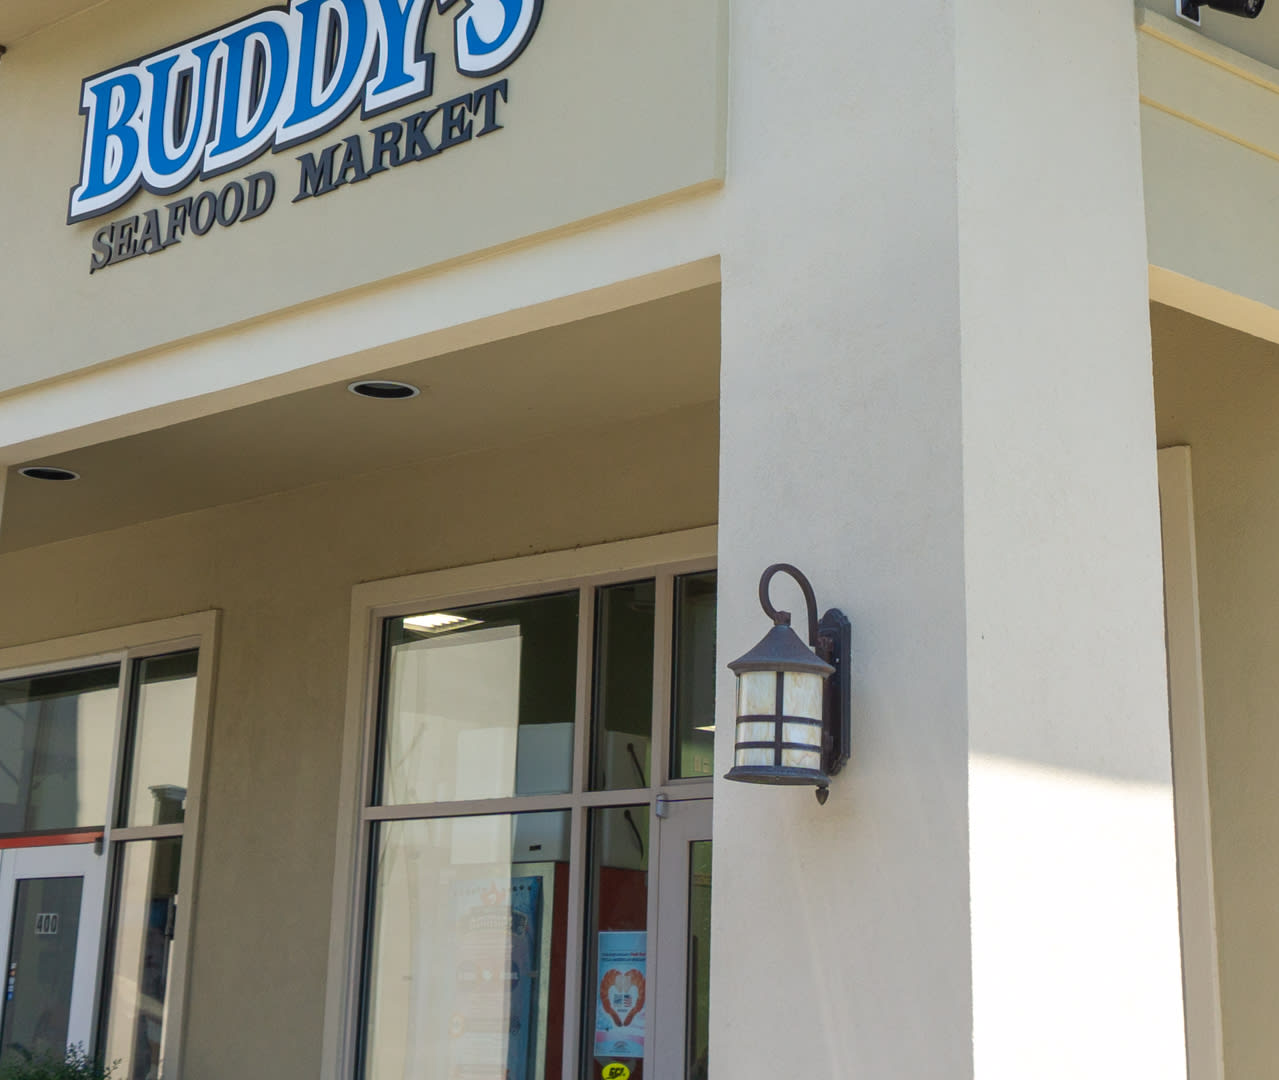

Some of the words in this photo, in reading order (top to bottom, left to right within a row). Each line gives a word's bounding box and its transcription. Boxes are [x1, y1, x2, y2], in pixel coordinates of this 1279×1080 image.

[90, 172, 276, 274] SEAFOOD
[293, 79, 508, 203] MARKET
[36, 914, 58, 933] 400
